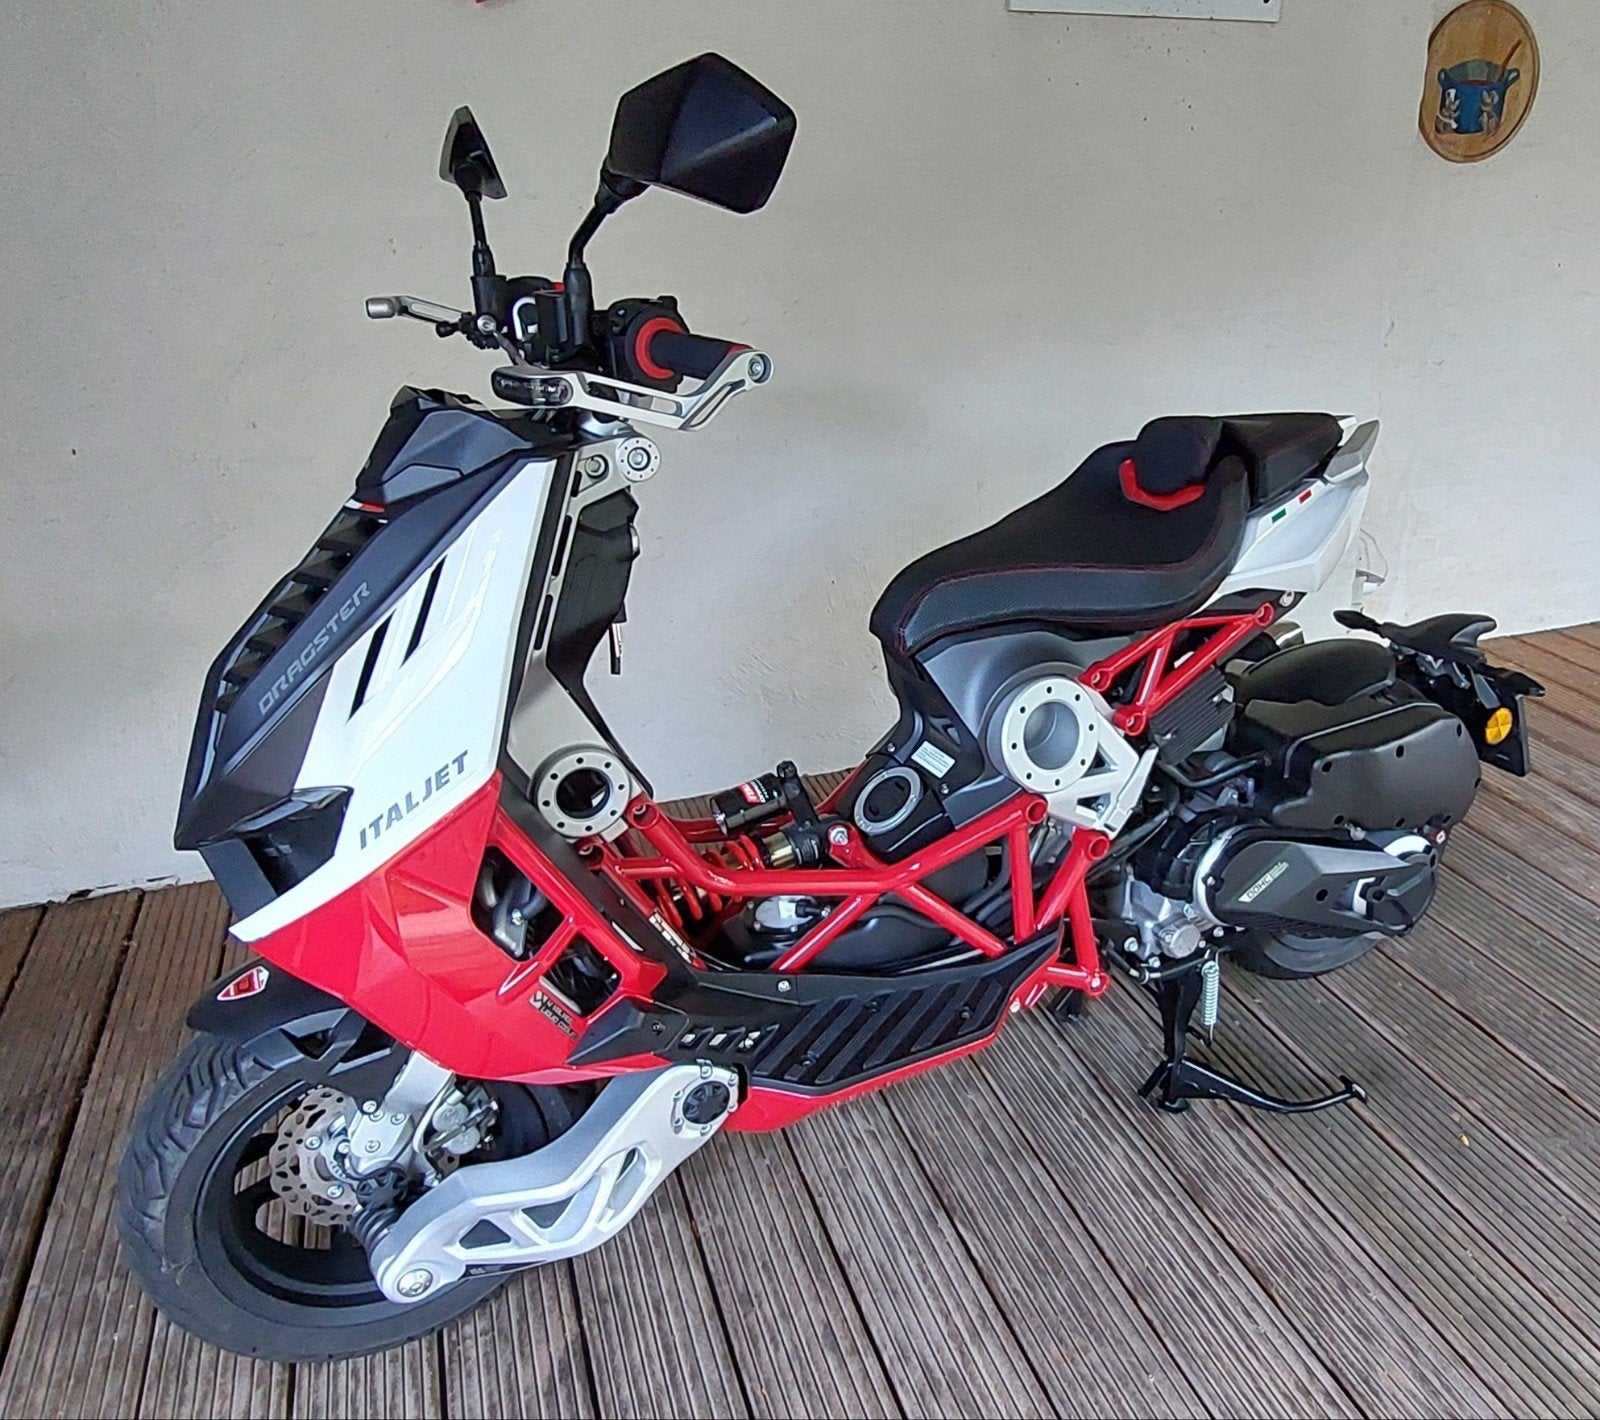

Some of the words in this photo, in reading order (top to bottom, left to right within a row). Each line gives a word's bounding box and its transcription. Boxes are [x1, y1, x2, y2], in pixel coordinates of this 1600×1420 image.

[258, 581, 370, 716] DRAGSTER
[359, 749, 468, 850] ITALJET
[1246, 874, 1272, 899] DOHC
